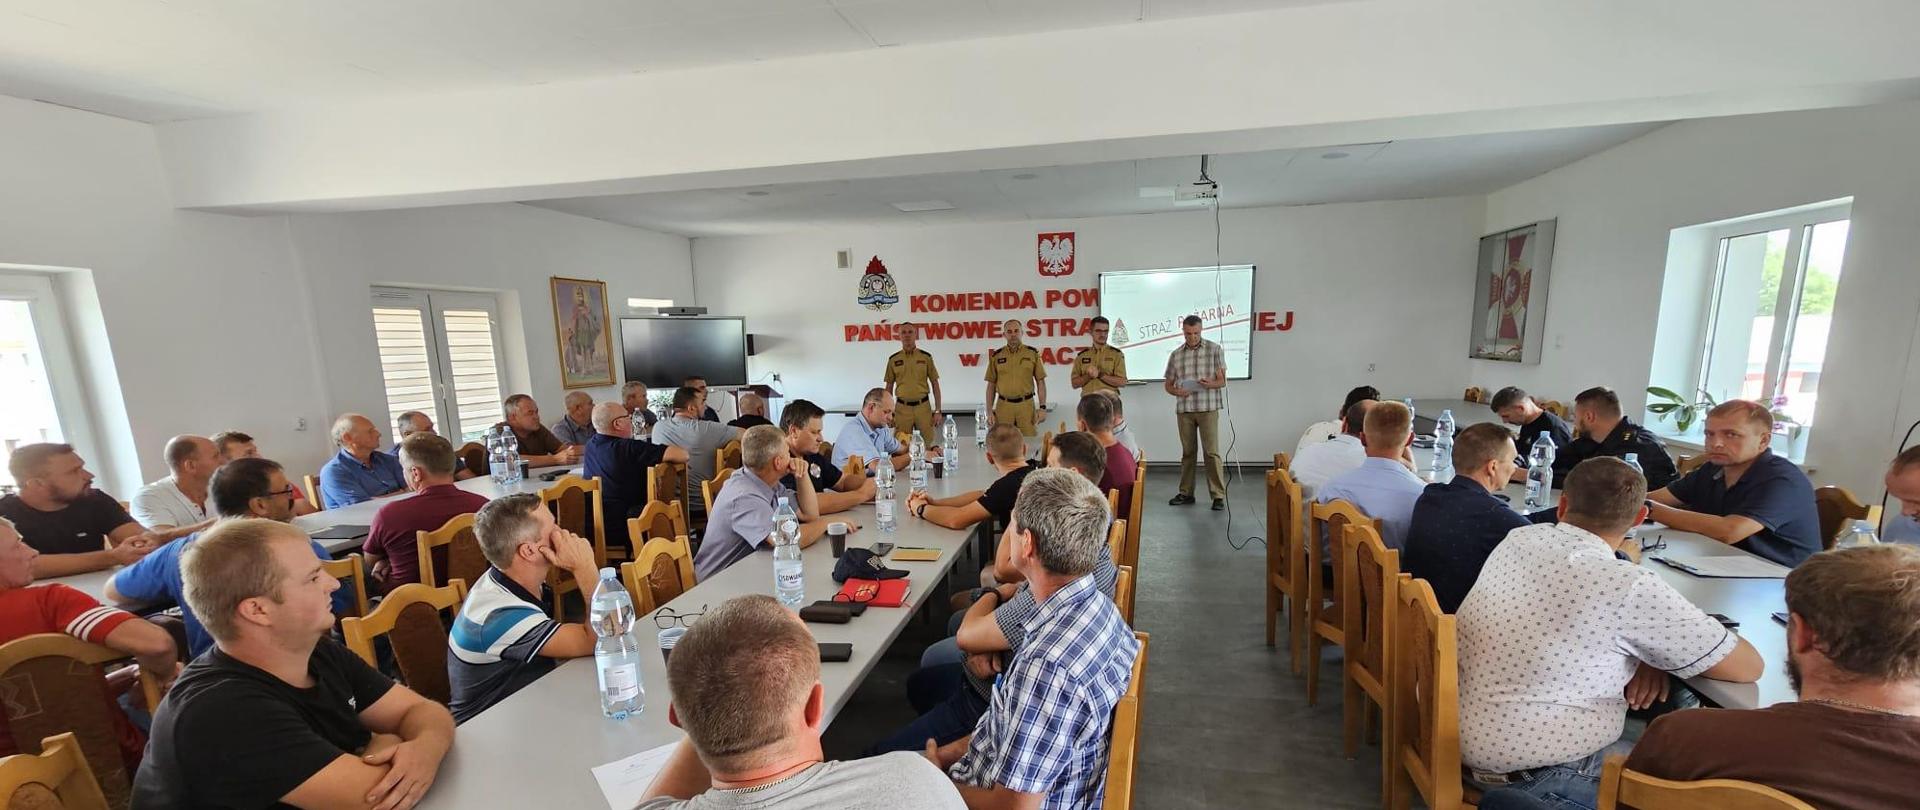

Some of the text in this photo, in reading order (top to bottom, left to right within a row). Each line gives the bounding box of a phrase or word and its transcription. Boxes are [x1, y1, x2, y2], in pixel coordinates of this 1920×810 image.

[910, 288, 1098, 313] KOMENDA POW
[844, 319, 1003, 342] PAŃSTWOWE
[1026, 317, 1091, 337] STRA
[958, 353, 980, 367] w
